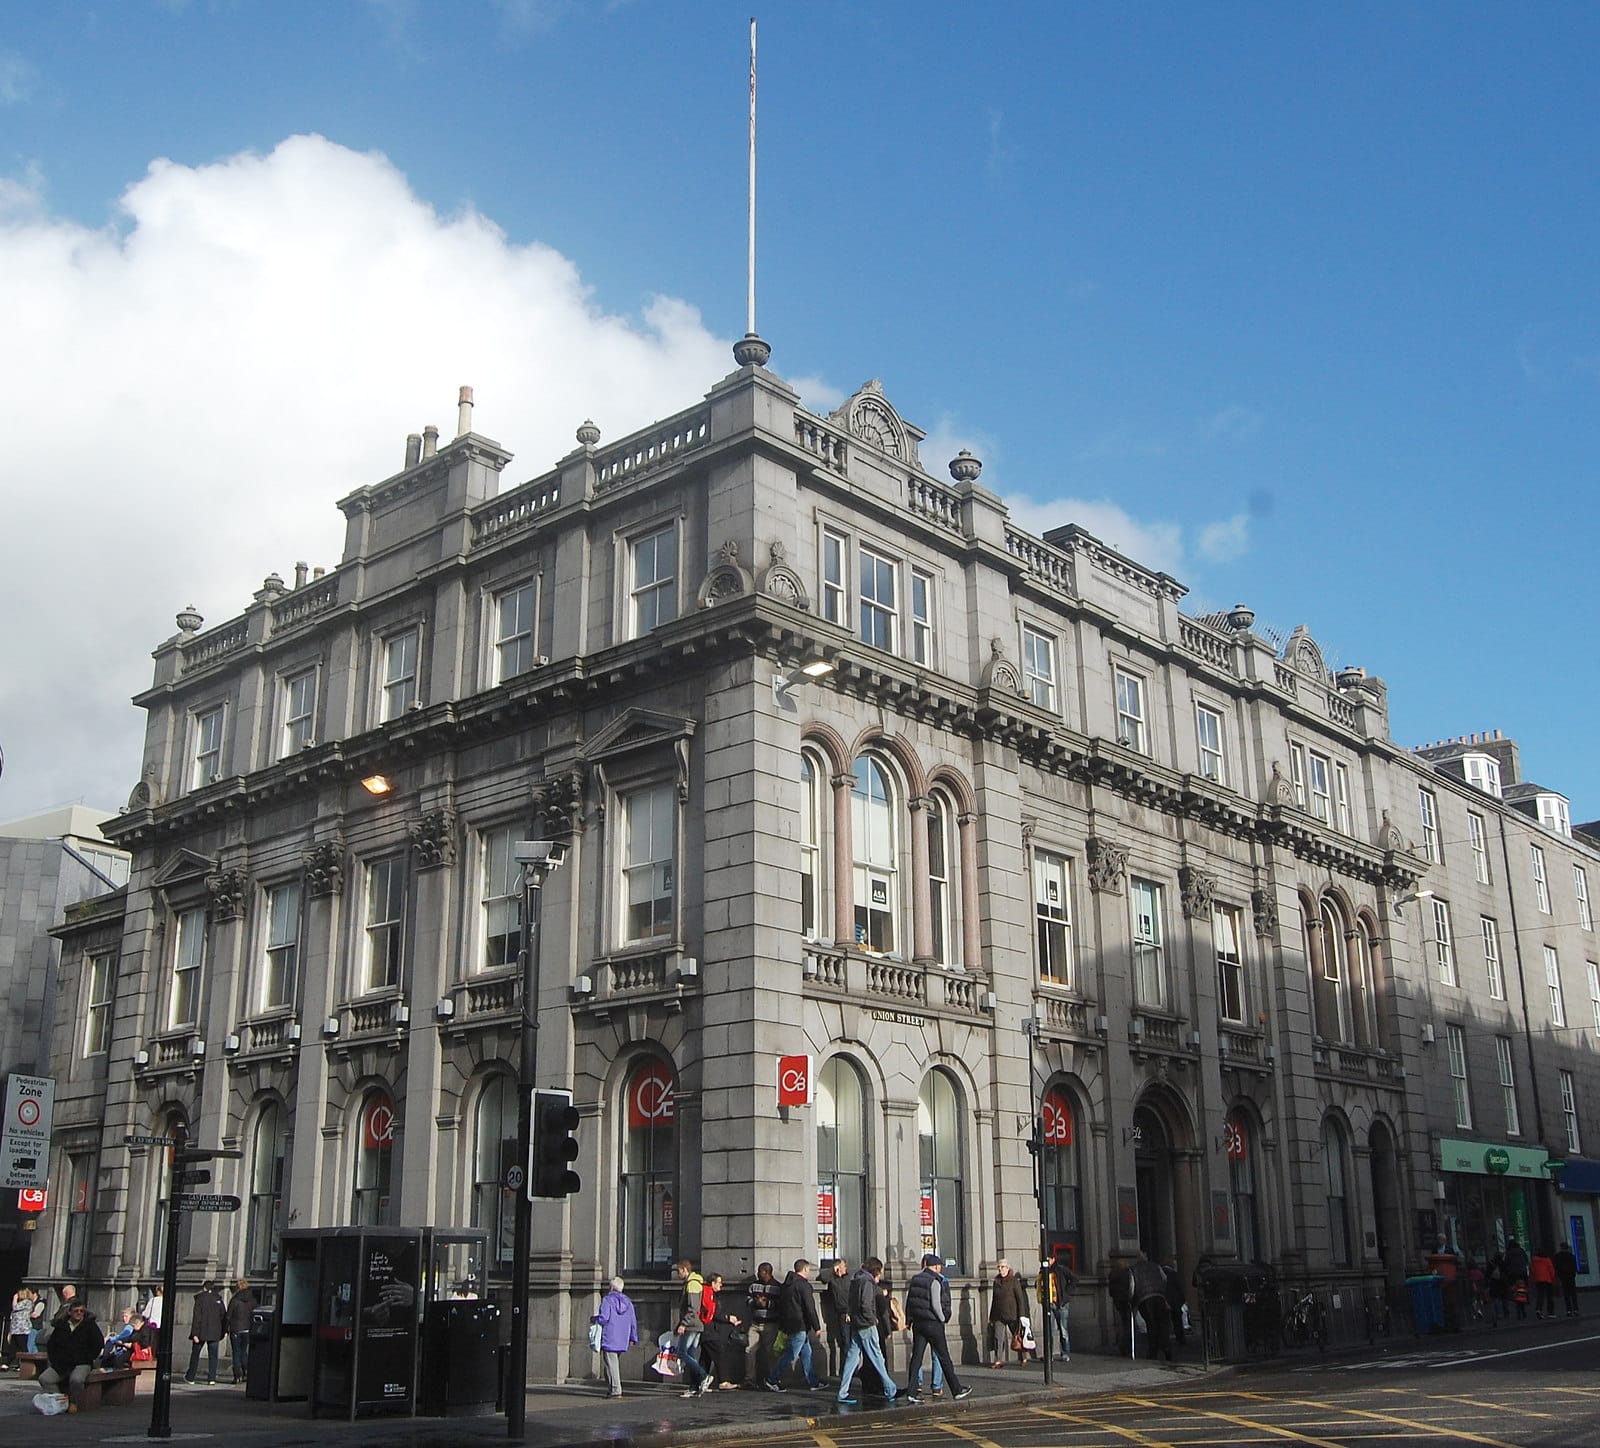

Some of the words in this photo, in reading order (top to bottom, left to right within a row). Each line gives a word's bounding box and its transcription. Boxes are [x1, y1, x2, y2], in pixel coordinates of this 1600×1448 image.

[873, 1010, 895, 1021] UNION
[896, 1013, 924, 1026] STREET
[16, 1076, 48, 1088] Pedestrian
[19, 1086, 43, 1098] Zone
[9, 1128, 18, 1136] No
[20, 1129, 45, 1138] vehicles
[9, 1139, 32, 1148] Except
[9, 1147, 32, 1156] loading
[33, 1149, 41, 1157] by
[10, 1171, 36, 1180] between
[509, 1171, 522, 1184] 20
